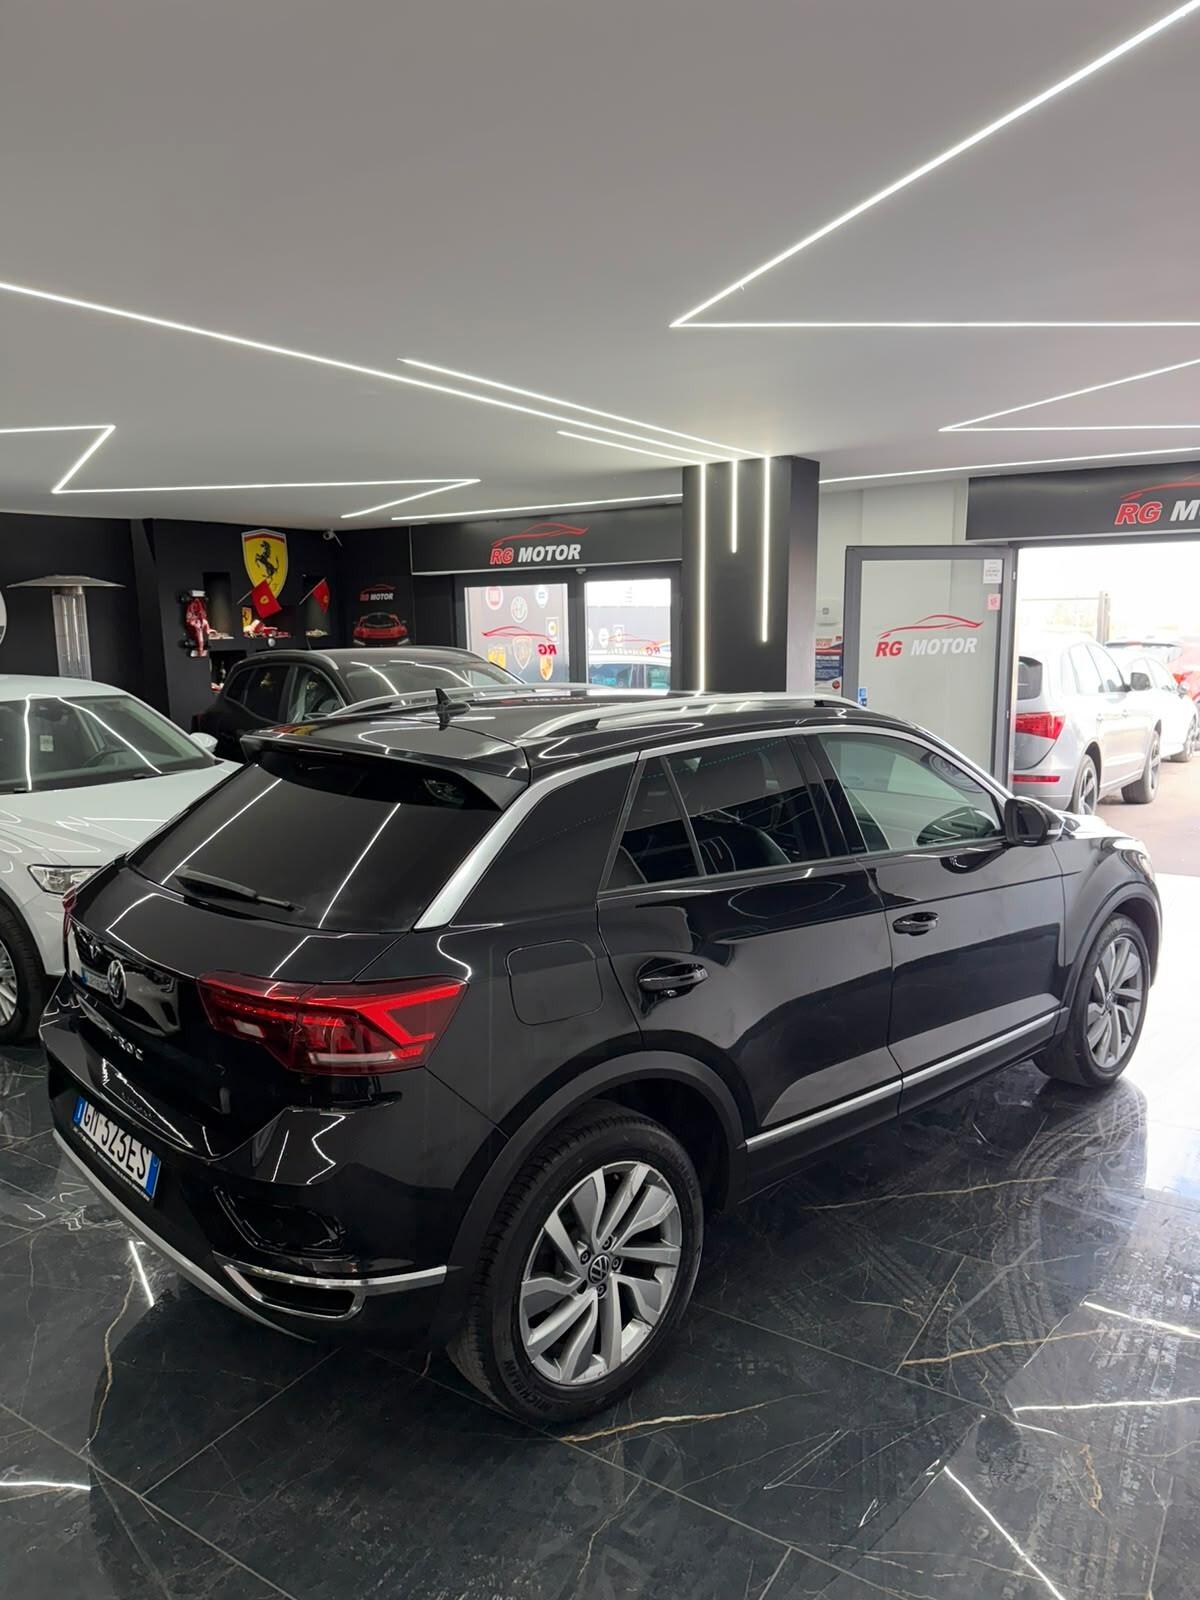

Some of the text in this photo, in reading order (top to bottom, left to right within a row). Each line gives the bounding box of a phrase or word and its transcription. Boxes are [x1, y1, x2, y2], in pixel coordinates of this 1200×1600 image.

[1114, 499, 1200, 525] RG M
[489, 544, 581, 565] RG MOTOR
[370, 592, 394, 601] MOTOR
[875, 637, 978, 658] RG MOTOR
